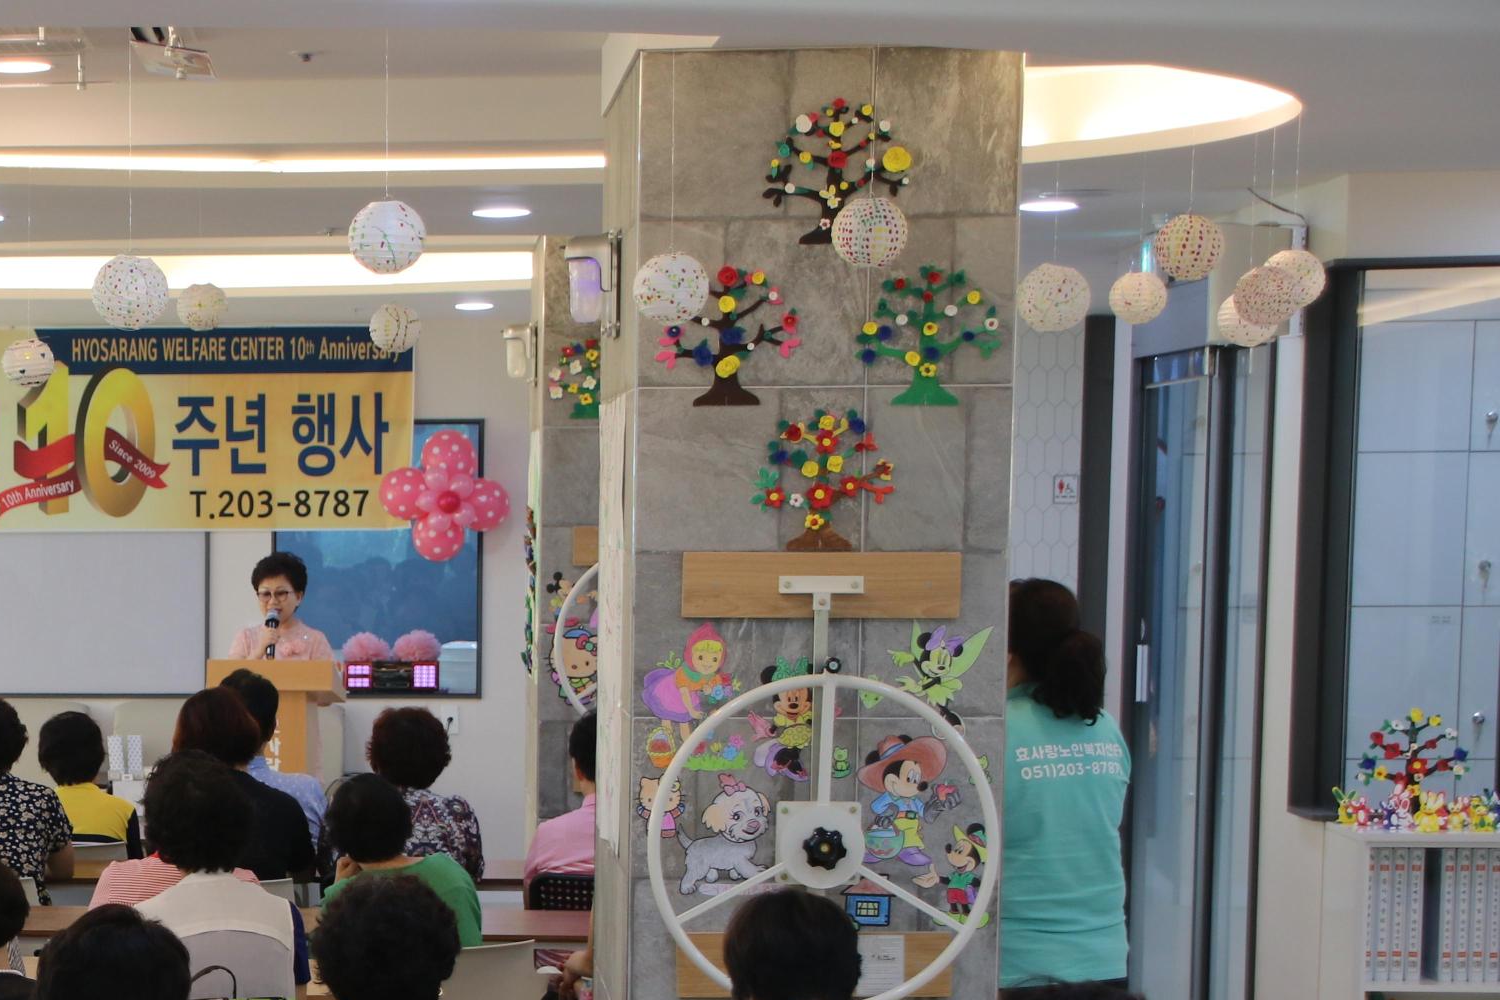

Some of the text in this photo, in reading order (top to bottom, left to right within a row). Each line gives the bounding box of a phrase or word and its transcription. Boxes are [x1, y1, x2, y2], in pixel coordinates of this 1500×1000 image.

[71, 337, 158, 363] HYOSARANG
[161, 336, 226, 362] WELFARE
[230, 336, 285, 361] CENTER
[290, 335, 315, 360] 10th
[171, 392, 267, 477] 주년
[290, 391, 390, 477] 행사
[108, 439, 157, 479] Since 2009
[1, 480, 75, 508] 10th Anniversary
[189, 489, 370, 520] T.203-8787
